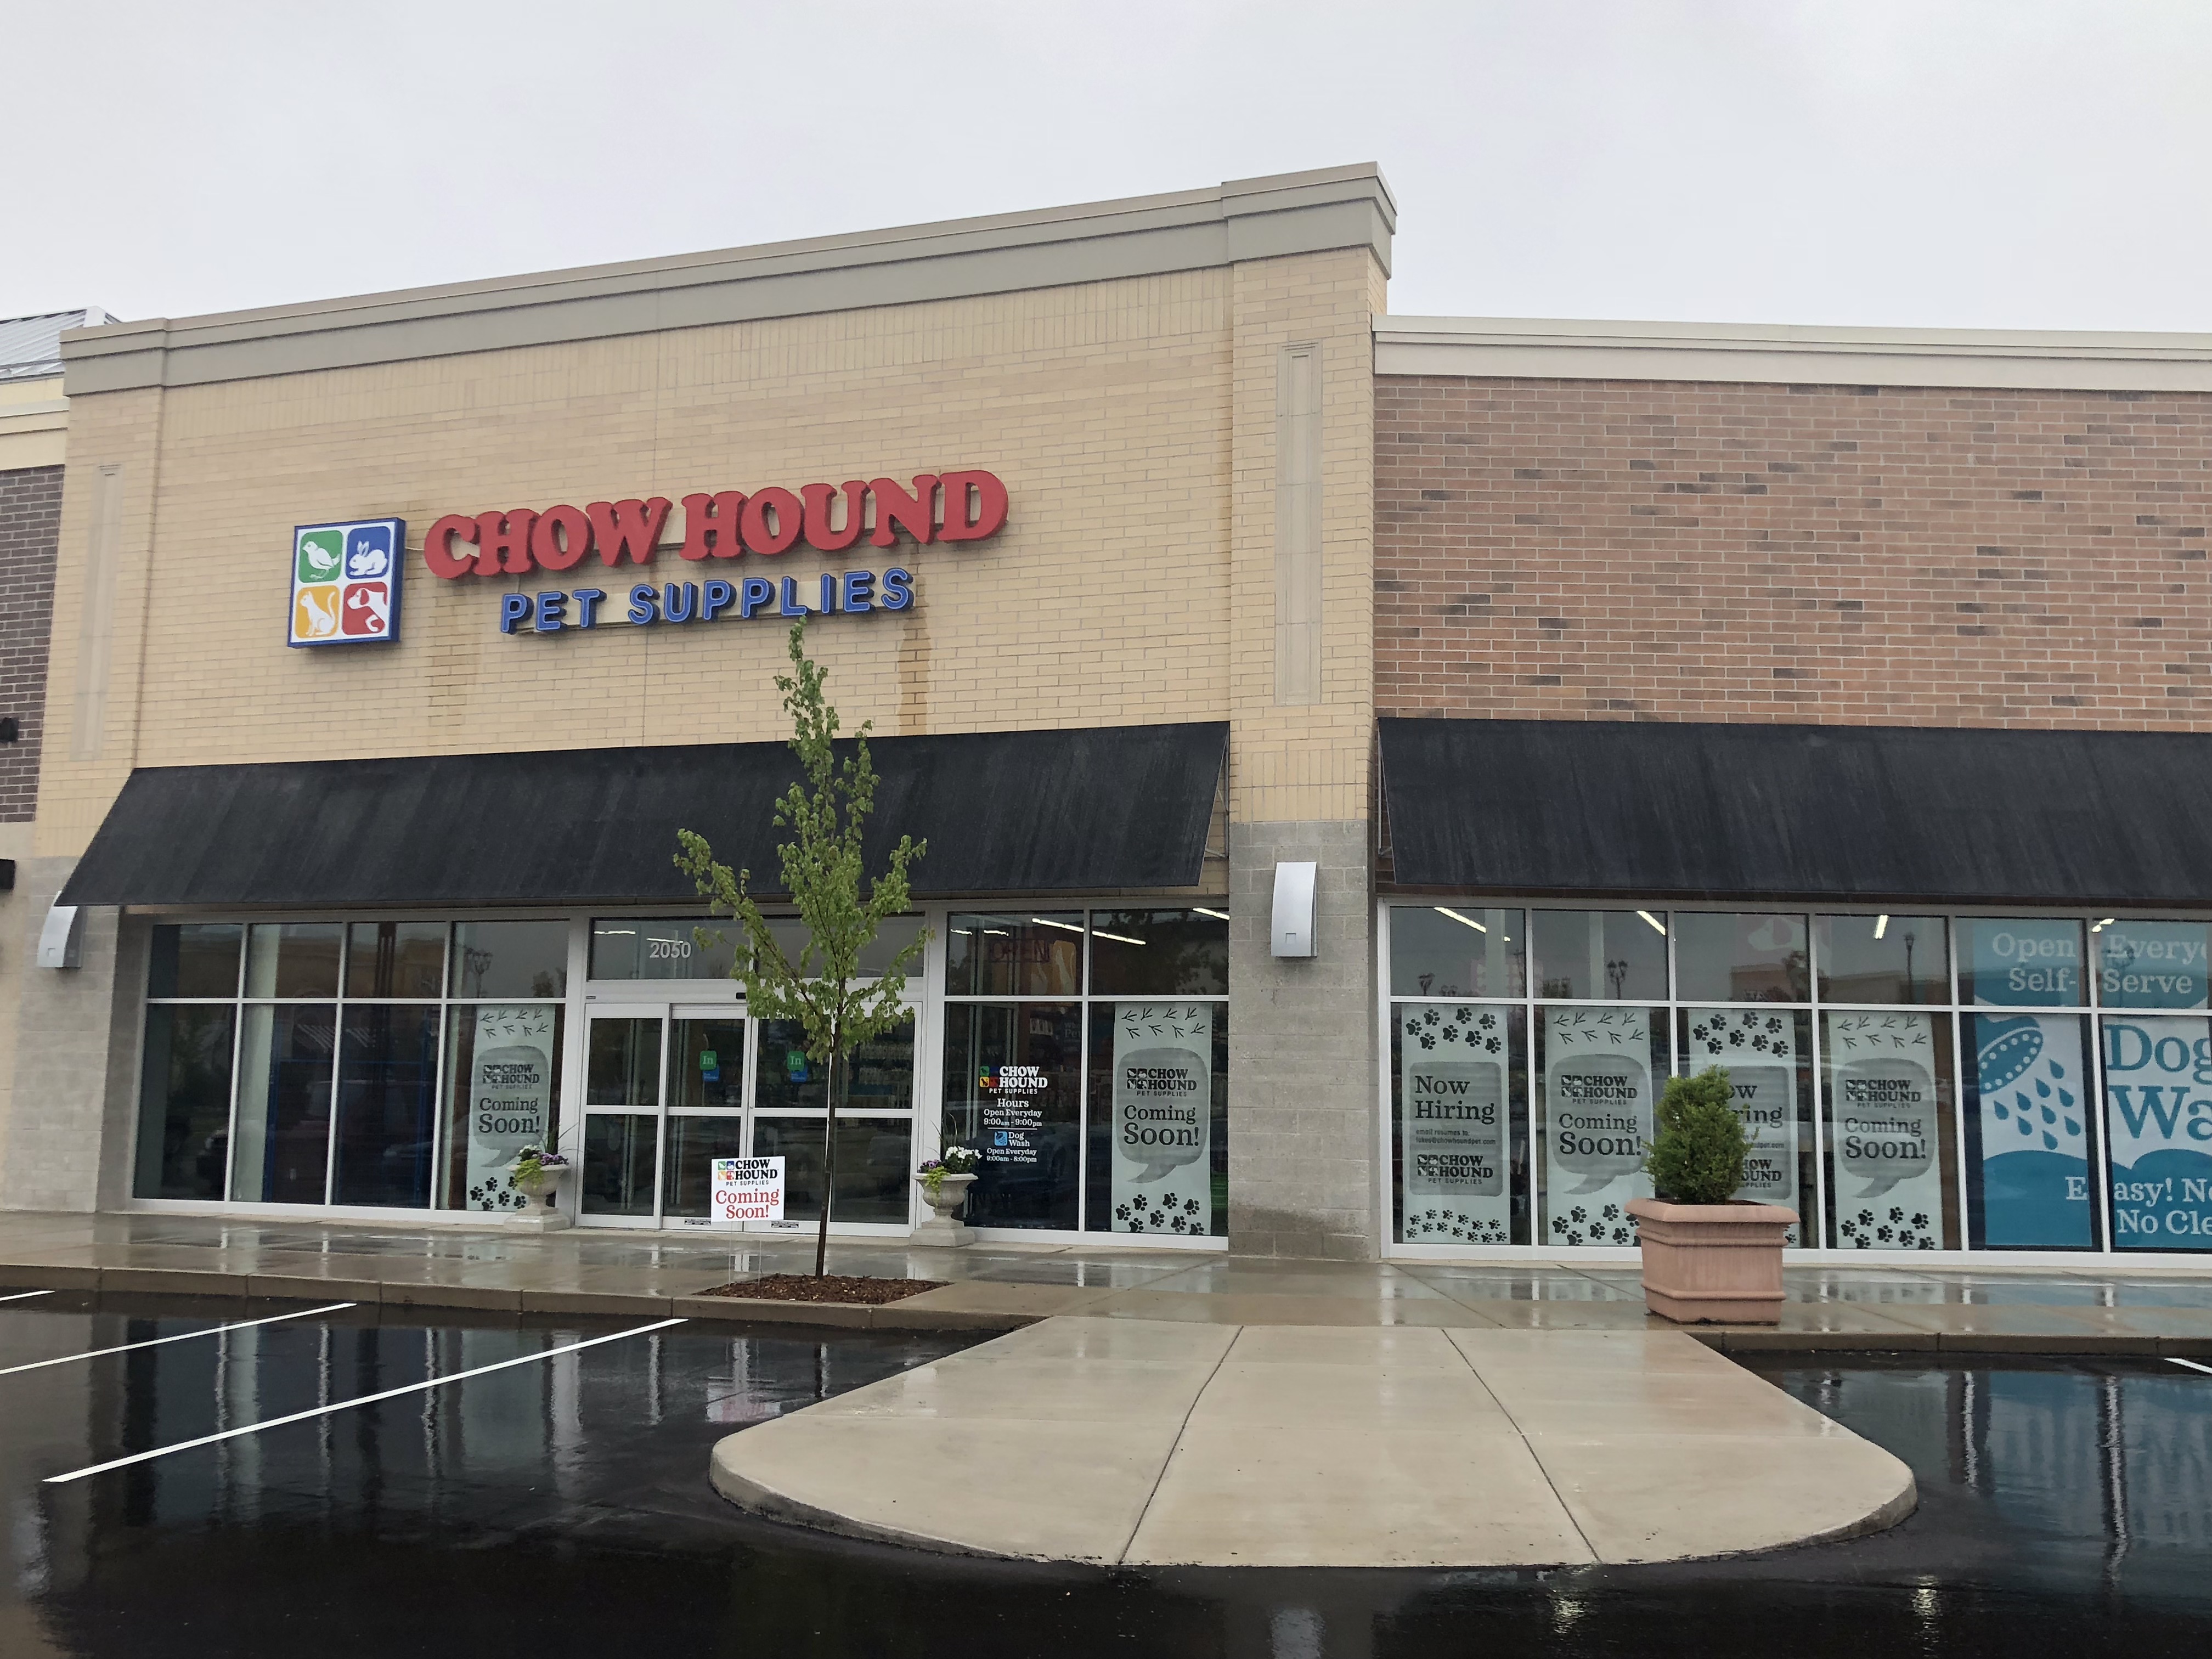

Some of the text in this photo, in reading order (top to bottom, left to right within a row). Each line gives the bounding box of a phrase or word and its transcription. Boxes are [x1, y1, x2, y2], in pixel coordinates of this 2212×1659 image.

[424, 470, 1009, 579] CHOW HOUND
[500, 567, 915, 635] PET SUPPLIES
[650, 941, 691, 958] 2050
[1993, 933, 2076, 962] Open
[702, 1056, 714, 1065] In
[789, 1056, 802, 1065] In
[503, 1064, 534, 1074] CHOW
[1000, 1066, 1040, 1077] CHOW
[1148, 1068, 1189, 1079] CHOW
[501, 1074, 540, 1084] HOUND
[999, 1077, 1048, 1088] HOUND
[1415, 1075, 1471, 1094] Now
[1583, 1075, 1628, 1087] CHOW
[1867, 1079, 1911, 1090] CHOW
[1148, 1080, 1197, 1091] HOUND
[1583, 1087, 1638, 1098] HOUND
[1868, 1091, 1921, 1102] HOUND
[479, 1097, 538, 1114] Coming
[997, 1098, 1029, 1107] Hours
[984, 1109, 1043, 1118] Open Everyday
[1124, 1105, 1196, 1125] Coming
[1415, 1099, 1495, 1125] Hiring
[479, 1113, 540, 1133] Soon!
[1015, 1118, 1042, 1127] 9:00pm
[1559, 1113, 1638, 1133] Coming
[1845, 1117, 1922, 1137] Coming
[1008, 1132, 1024, 1140] Dog
[1124, 1122, 1199, 1147] Soon!
[1560, 1131, 1641, 1155] Soon!
[1846, 1135, 1926, 1159] Soon!
[735, 1159, 770, 1170] CHOW
[1439, 1154, 1483, 1166] CHOW
[735, 1169, 778, 1180] HOUND
[1439, 1166, 1493, 1178] HOUND
[715, 1188, 779, 1206] Coming
[726, 1205, 769, 1219] Soon!
[2117, 1209, 2159, 1234] No
